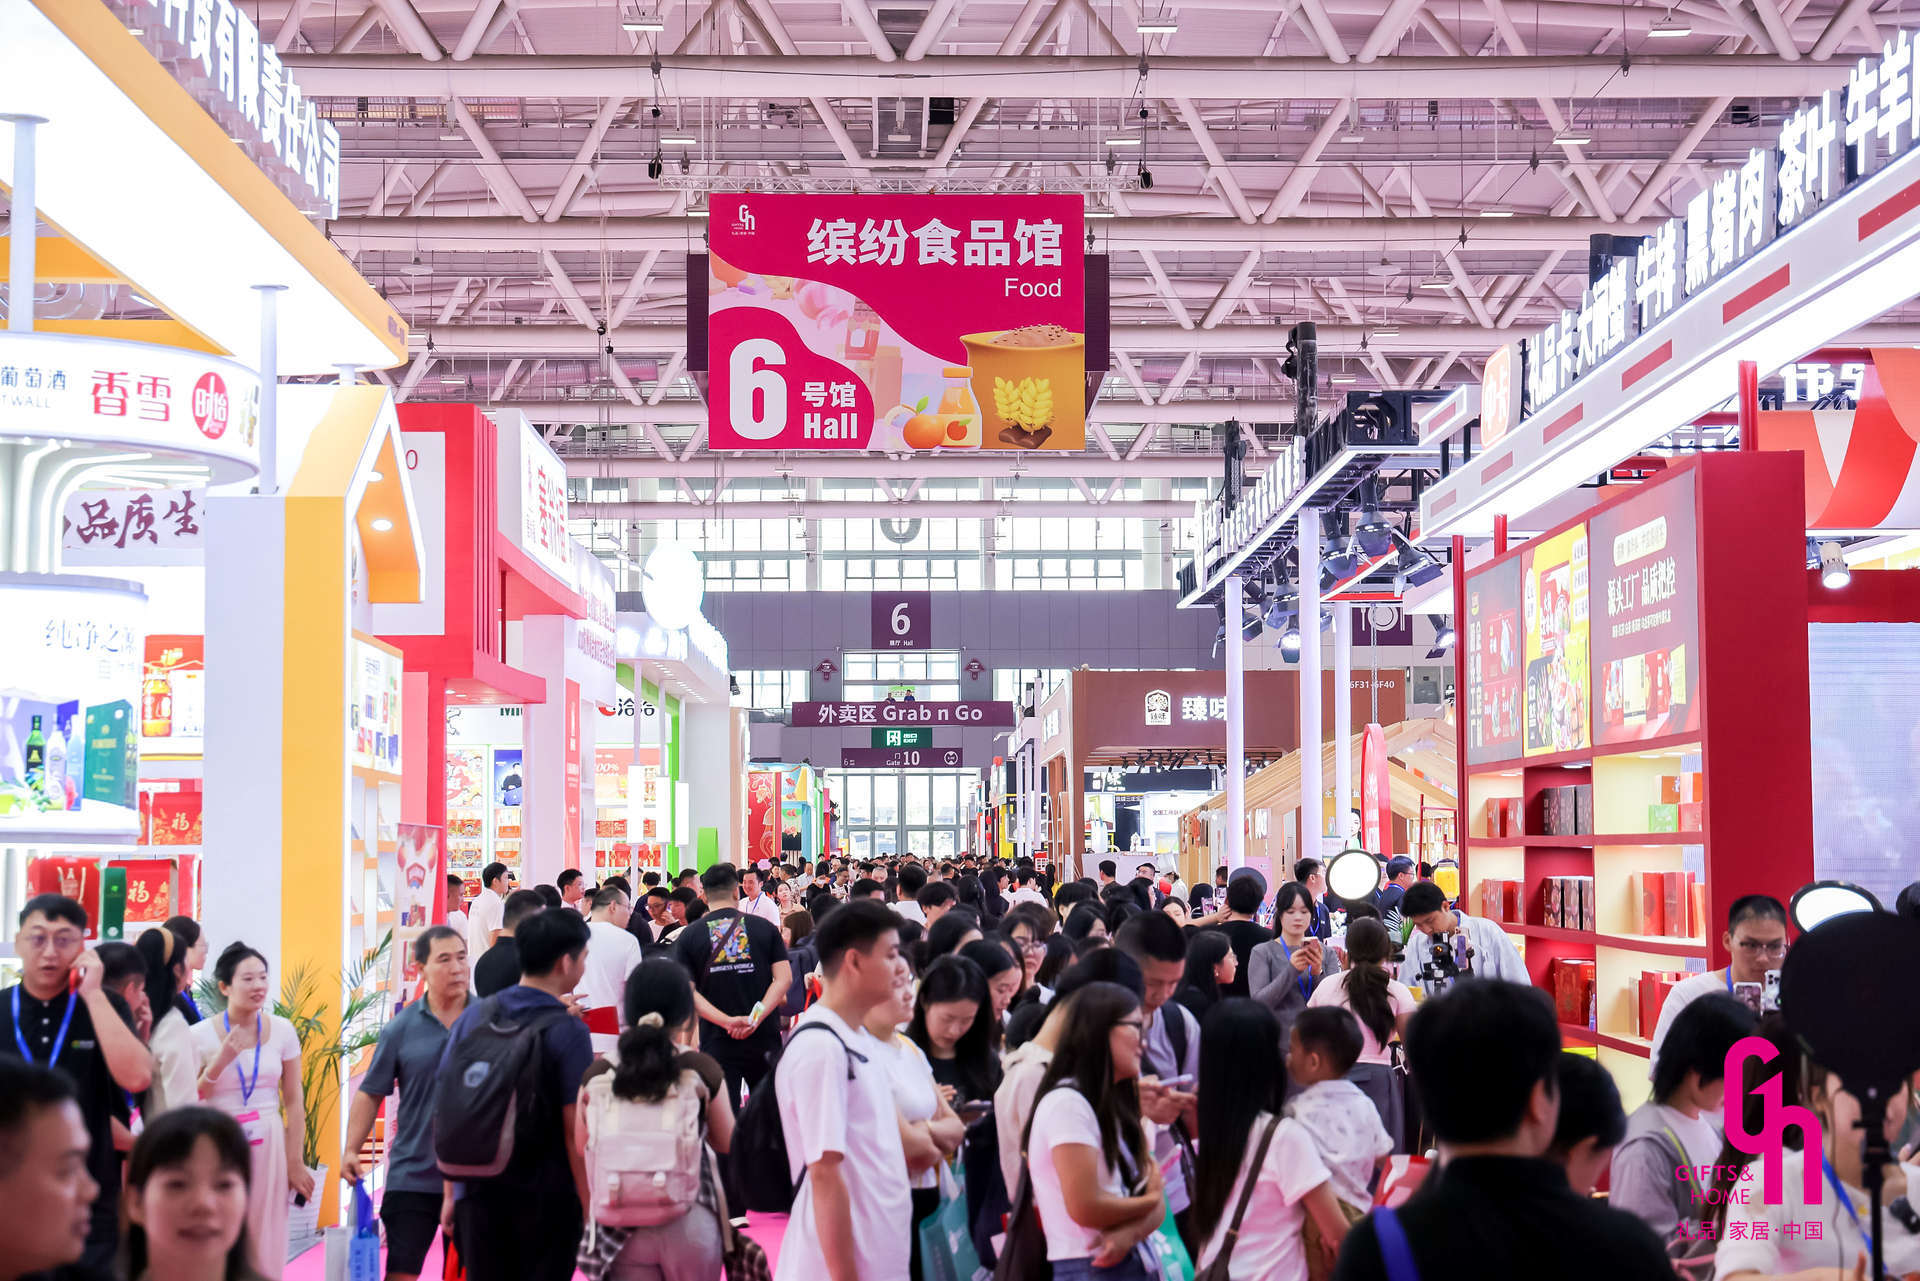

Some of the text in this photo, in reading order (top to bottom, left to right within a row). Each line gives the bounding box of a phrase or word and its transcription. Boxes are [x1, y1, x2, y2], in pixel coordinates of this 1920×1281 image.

[1685, 148, 1767, 296] 黑猪肉
[1778, 90, 1837, 226] 茶叶
[1846, 30, 1920, 175] 牛羊
[807, 218, 1063, 267] 缤纷食品馆
[1004, 278, 1063, 298] Food
[1, 366, 67, 391] 葡萄酒
[729, 338, 788, 441] 6
[91, 370, 171, 422] 香雪
[801, 381, 857, 409] 号馆
[803, 412, 858, 439] Hall
[76, 490, 206, 549] 品质生
[891, 602, 911, 635] 6
[818, 704, 983, 723] 外卖区 Grab n Go
[1182, 696, 1227, 721] 臻味
[903, 751, 920, 765] 10
[172, 812, 190, 831] 福
[128, 880, 150, 903] 福
